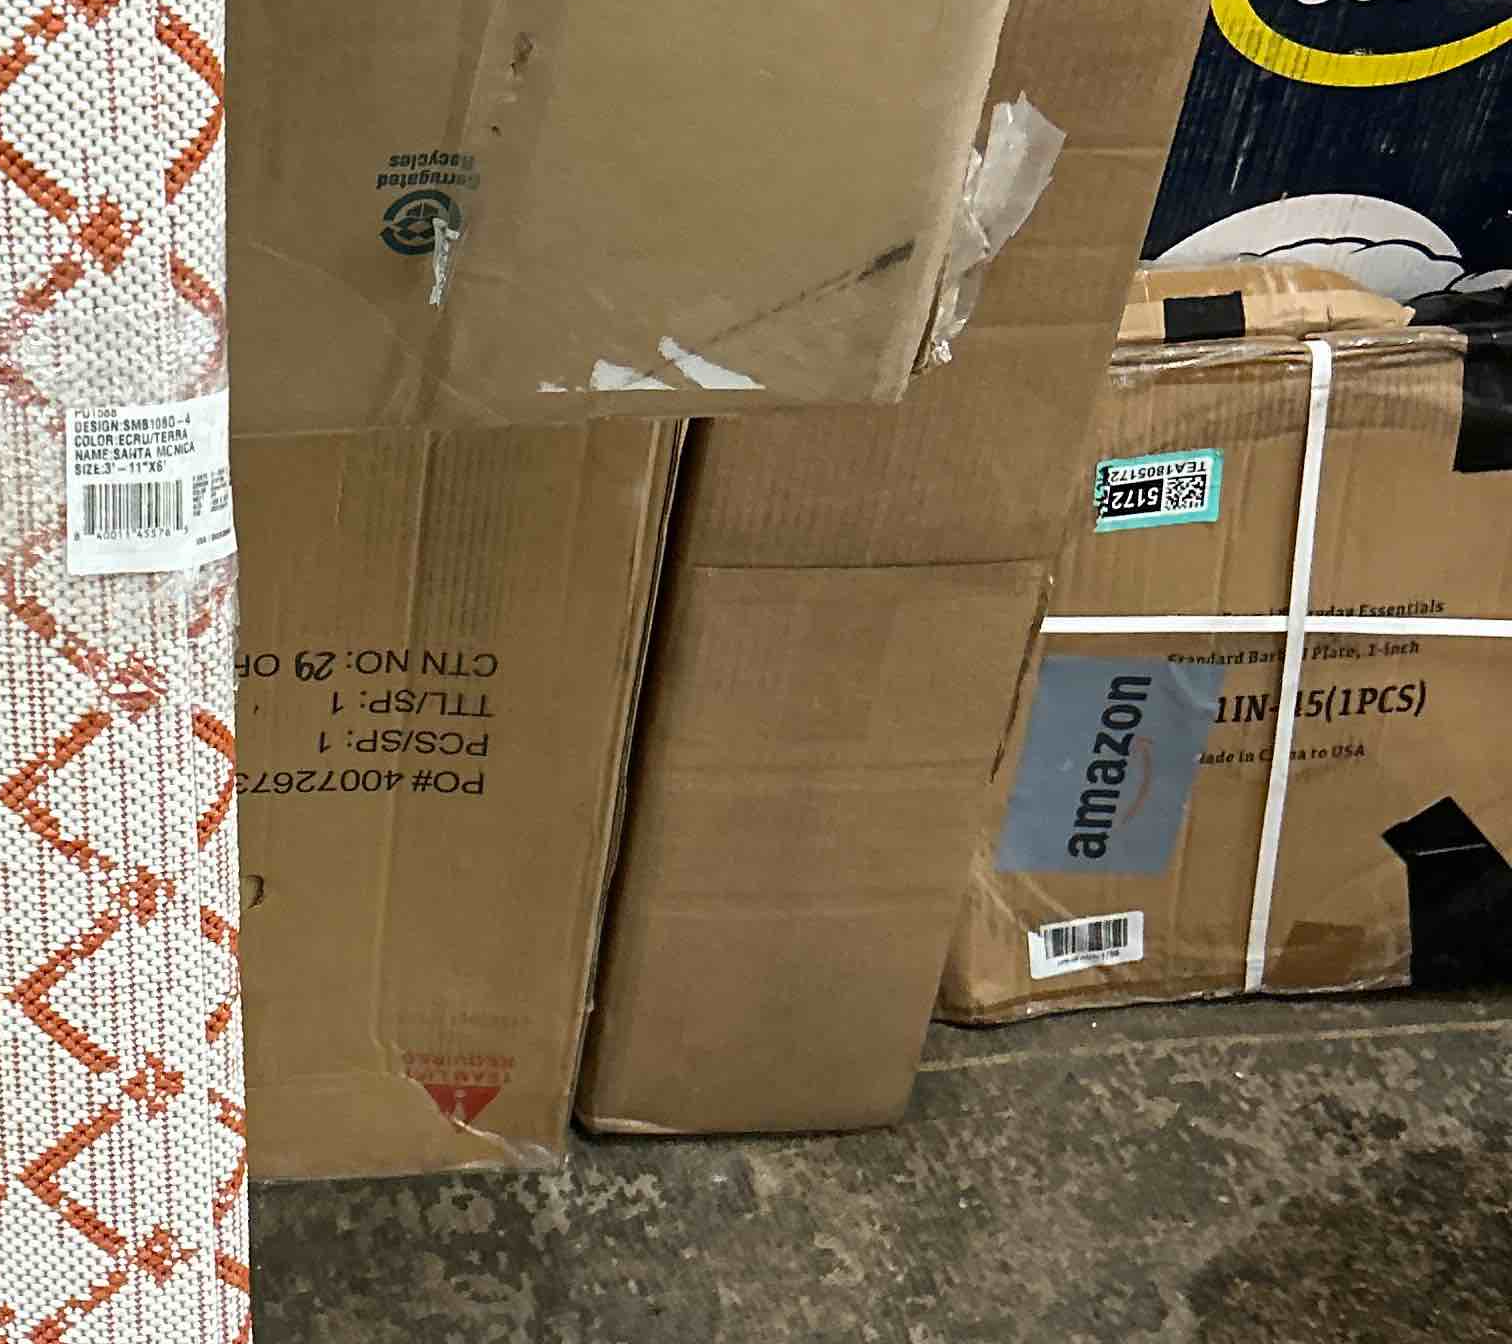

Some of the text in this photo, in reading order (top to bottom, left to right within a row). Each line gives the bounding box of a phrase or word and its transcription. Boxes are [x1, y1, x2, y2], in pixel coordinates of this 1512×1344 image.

[1110, 460, 1207, 483] TEA1805172
[1111, 487, 1159, 510] 5172
[1358, 599, 1446, 618] Essentials
[295, 650, 337, 682] 29
[345, 650, 410, 675] NO:
[421, 651, 499, 678] CTN
[331, 689, 496, 718] TTL/SP: 1
[317, 729, 489, 757] PCS/SP: 1
[1332, 742, 1366, 758] USA
[1068, 676, 1153, 859] amazon
[411, 769, 485, 795] PO#
